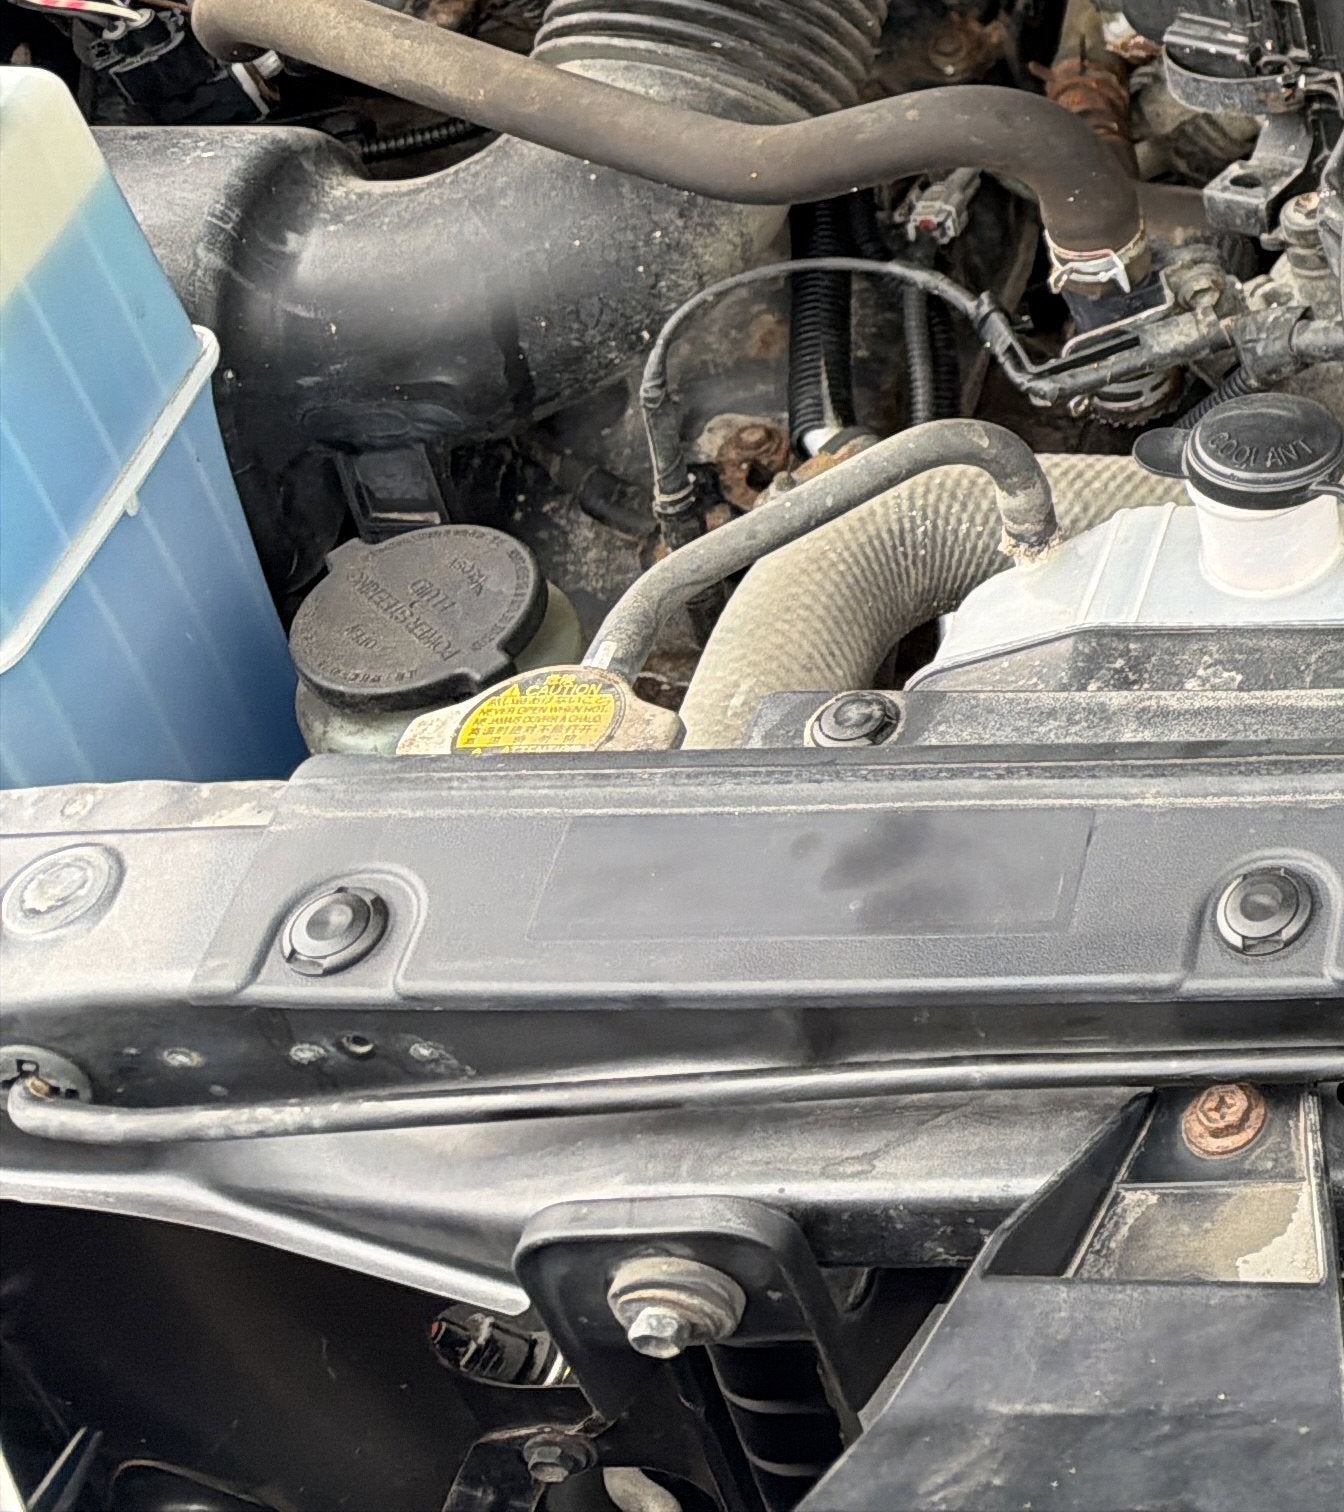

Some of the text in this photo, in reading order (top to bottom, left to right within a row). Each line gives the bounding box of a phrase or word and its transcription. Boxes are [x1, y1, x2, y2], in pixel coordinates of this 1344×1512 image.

[1207, 431, 1313, 470] COOLANT
[346, 569, 415, 625] STEERING
[408, 577, 457, 613] FLUID
[405, 615, 461, 662] POWER
[525, 683, 604, 697] CAUTION
